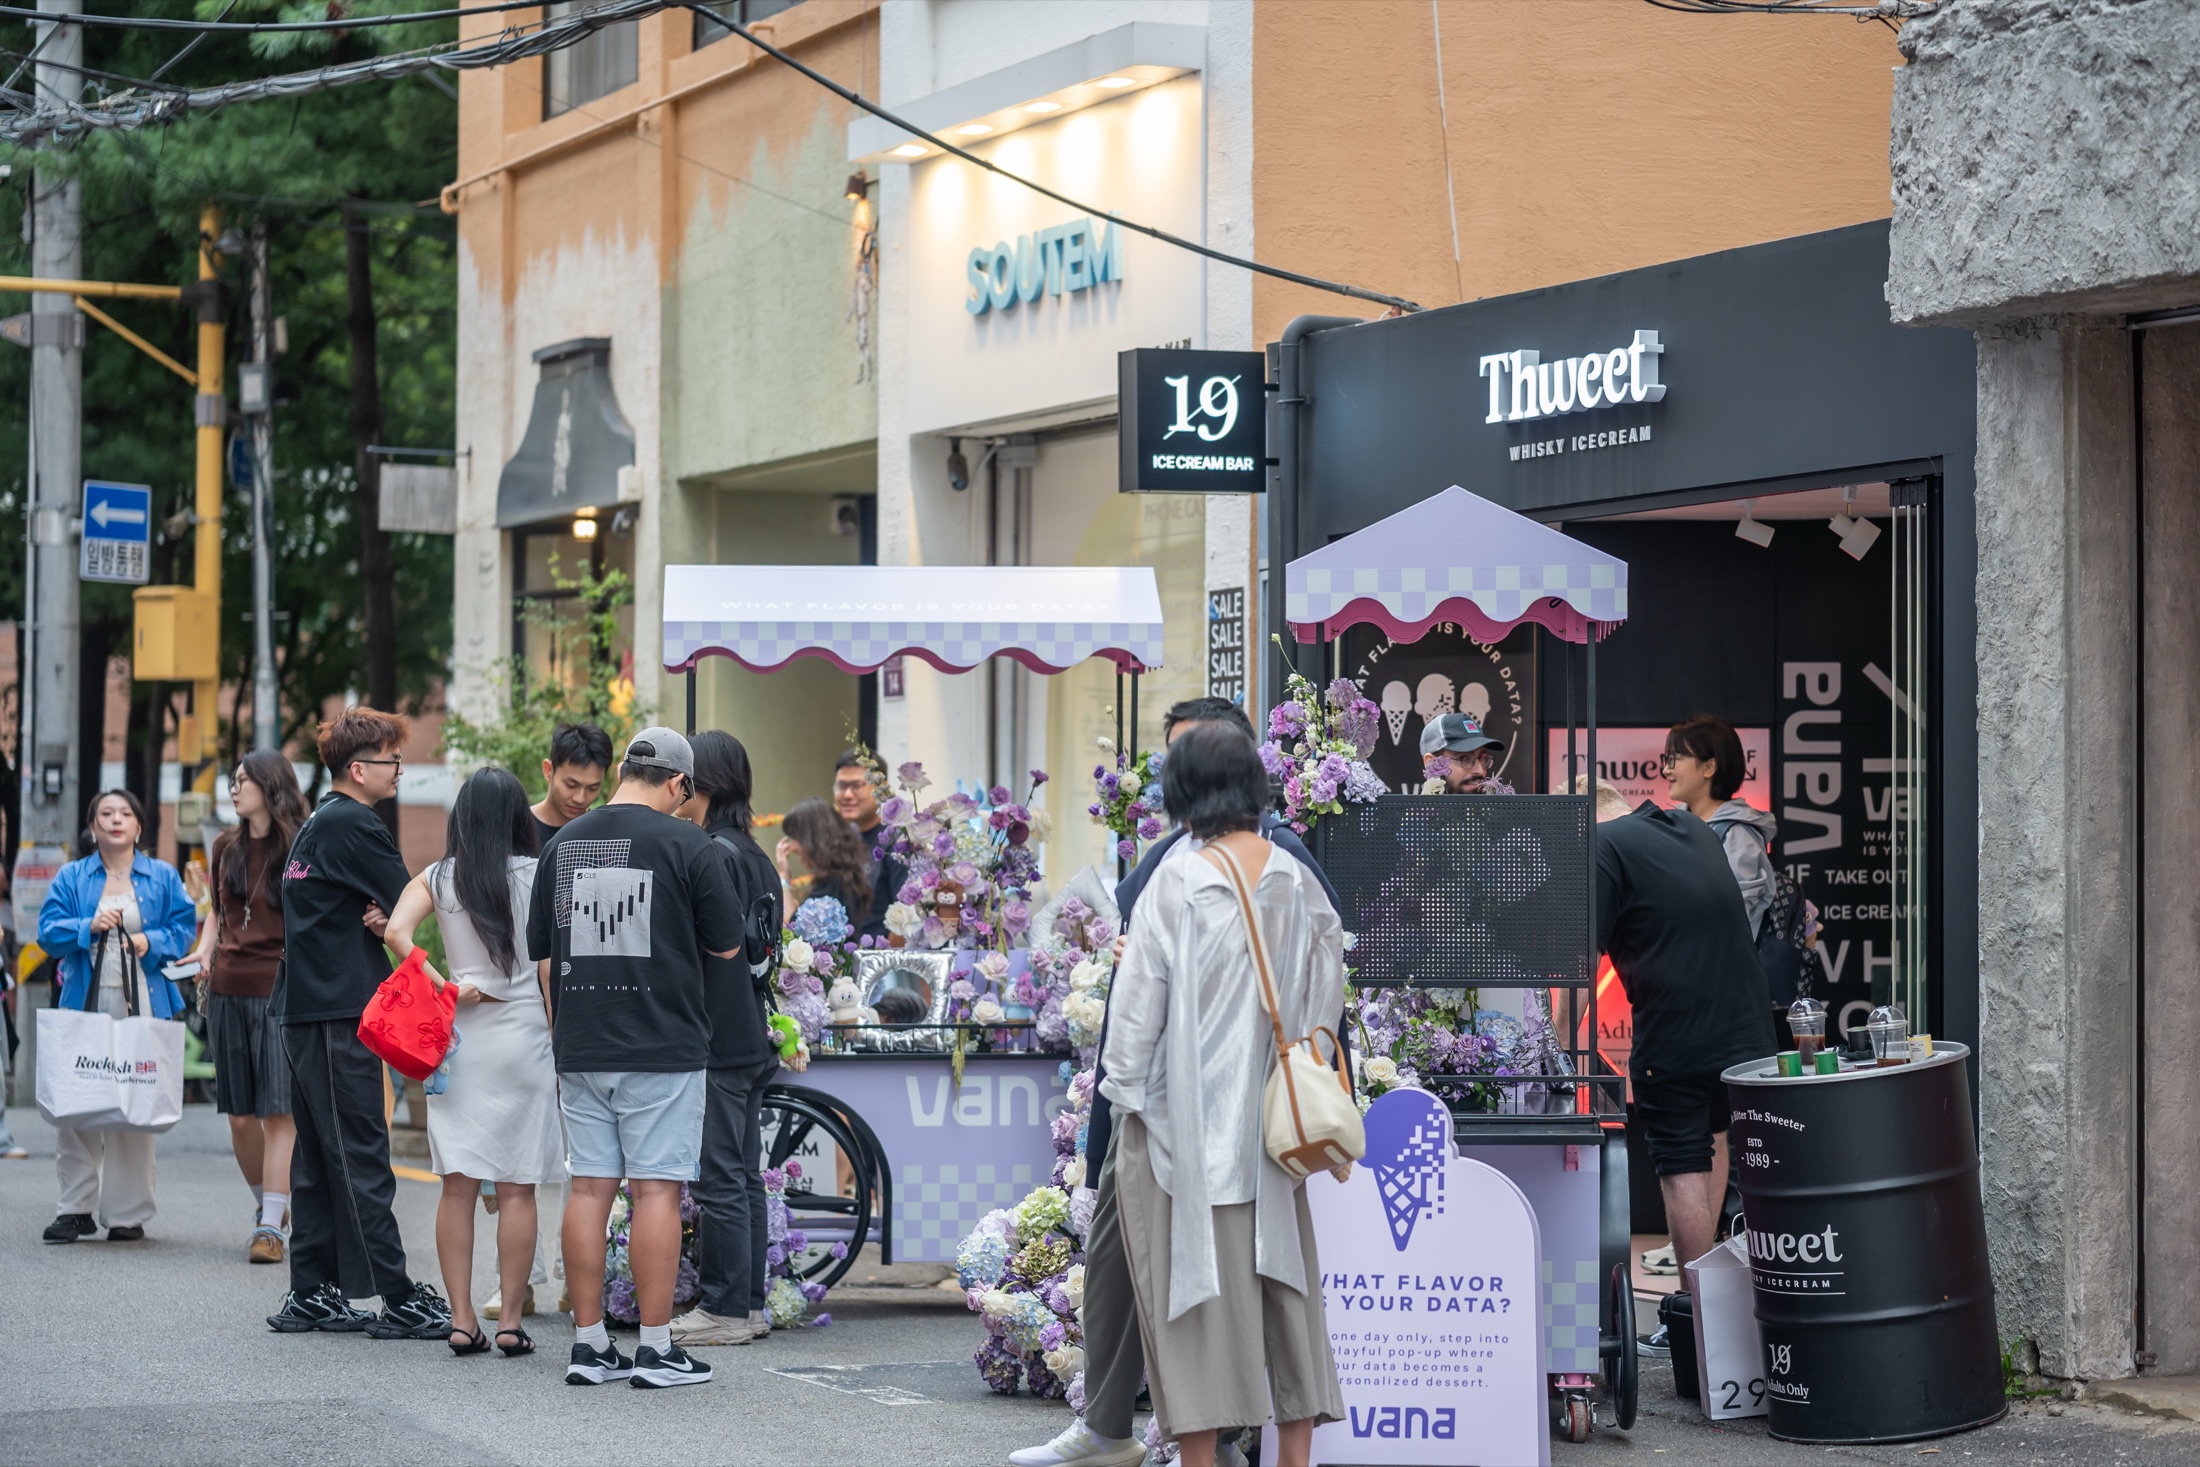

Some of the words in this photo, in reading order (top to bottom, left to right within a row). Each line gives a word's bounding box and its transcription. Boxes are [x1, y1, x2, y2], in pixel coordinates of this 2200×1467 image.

[966, 210, 1122, 316] SOUTEM
[1479, 329, 1666, 424] Thweet
[1163, 375, 1242, 442] 19
[1509, 438, 1565, 462] WHISKY
[1571, 425, 1652, 451] ICECREAM
[1153, 454, 1176, 469] ICE
[1176, 455, 1224, 470] CREAM
[1225, 456, 1255, 471] BAR
[87, 541, 144, 578] 일방통행
[721, 601, 795, 611] WHAT
[806, 602, 905, 611] FLAVOR
[917, 602, 940, 611] IS
[951, 602, 1019, 611] YOUR
[1031, 602, 1109, 612] DATA?
[1211, 622, 1242, 649] SALE
[1211, 652, 1242, 678] SALE
[1783, 662, 1842, 856] vana
[1824, 869, 1868, 885] TAKE
[1824, 905, 1852, 920] ICE
[1855, 905, 1917, 920] CREAM
[1747, 1109, 1763, 1121] The
[1764, 1111, 1806, 1132] Sweeter
[1747, 1138, 1763, 1148] ESTD
[1398, 1275, 1503, 1292] FLAVOR
[1767, 1277, 1831, 1288] ICECREAM
[1341, 1295, 1413, 1311] YOUR
[1427, 1297, 1511, 1313] DATA?
[1331, 1332, 1357, 1341] one
[1364, 1332, 1390, 1345] day
[1396, 1332, 1433, 1344] only,
[1440, 1333, 1472, 1344] step
[1479, 1333, 1509, 1344] into
[1389, 1348, 1442, 1359] pop-up
[1449, 1348, 1494, 1359] where
[1364, 1361, 1396, 1371] data
[1403, 1362, 1469, 1373] becomes
[1476, 1365, 1484, 1373] a
[1339, 1376, 1419, 1387] rsonalized
[1426, 1377, 1489, 1388] dessert.
[1787, 1383, 1810, 1399] Only
[1350, 1406, 1456, 1440] vana
